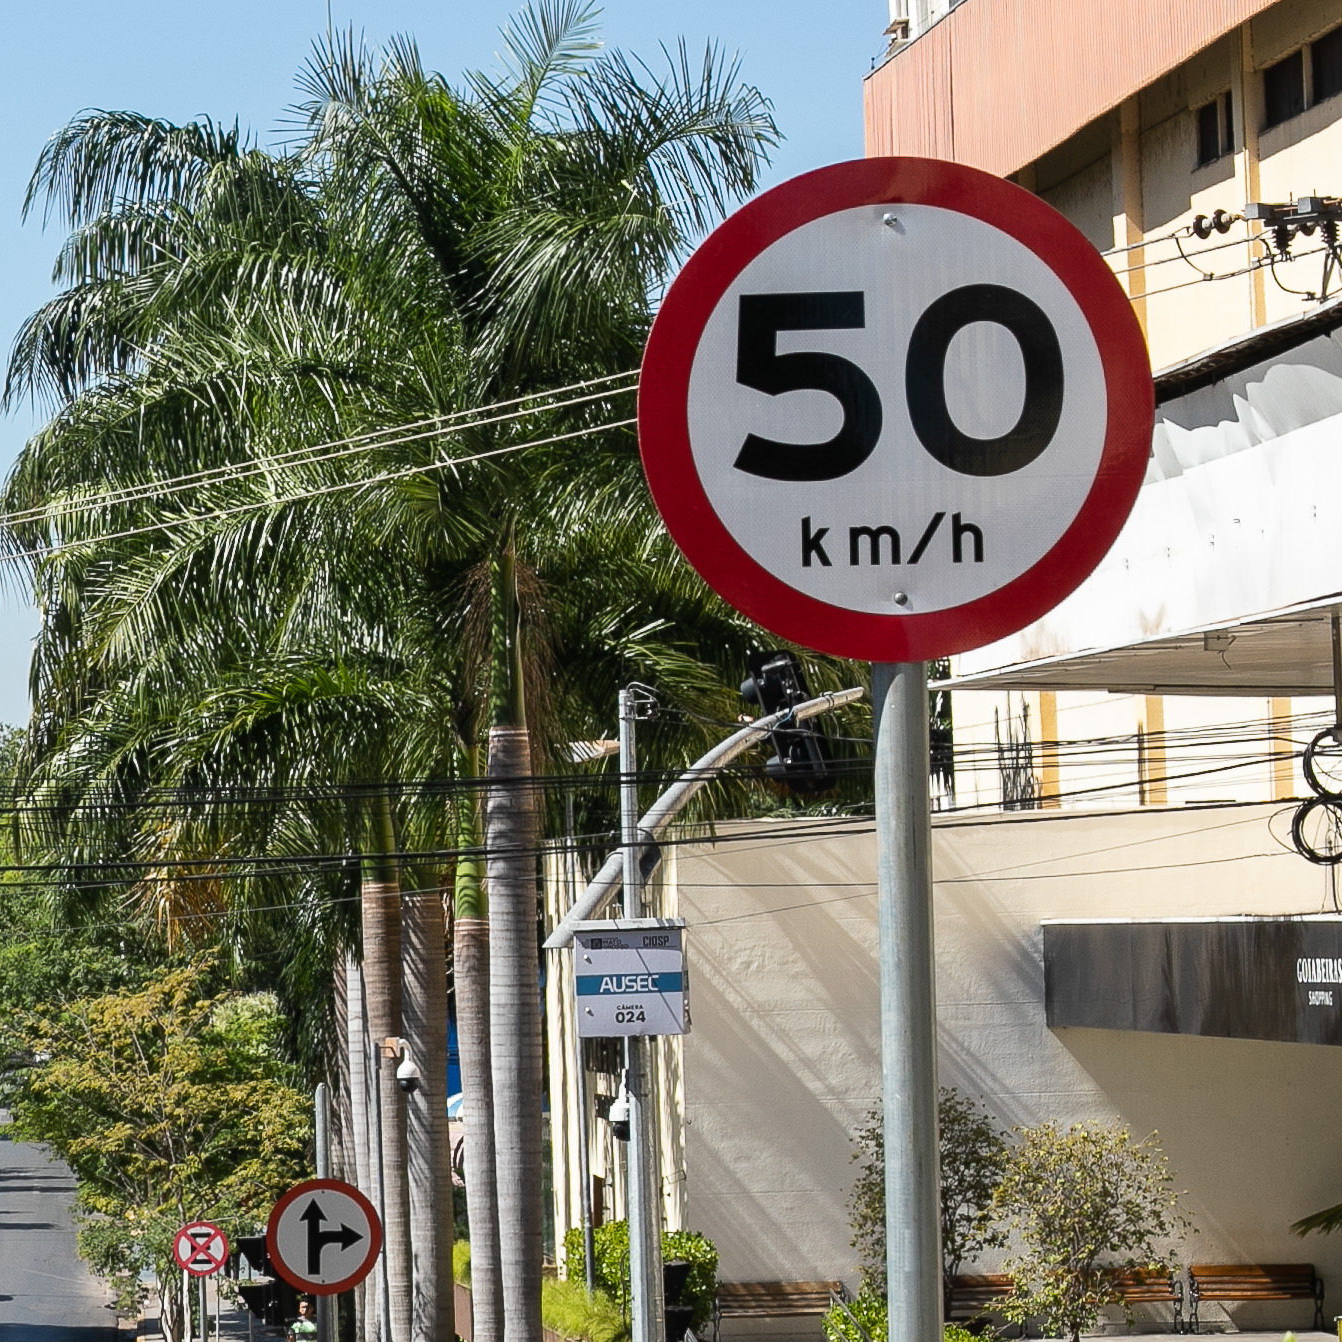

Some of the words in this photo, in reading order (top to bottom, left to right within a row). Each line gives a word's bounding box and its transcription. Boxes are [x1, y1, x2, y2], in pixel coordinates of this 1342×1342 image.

[733, 283, 1064, 481] 50
[801, 511, 984, 567] km/h
[643, 935, 670, 947] CIOSP
[599, 975, 659, 993] AUSEC
[615, 1010, 646, 1024] 024
